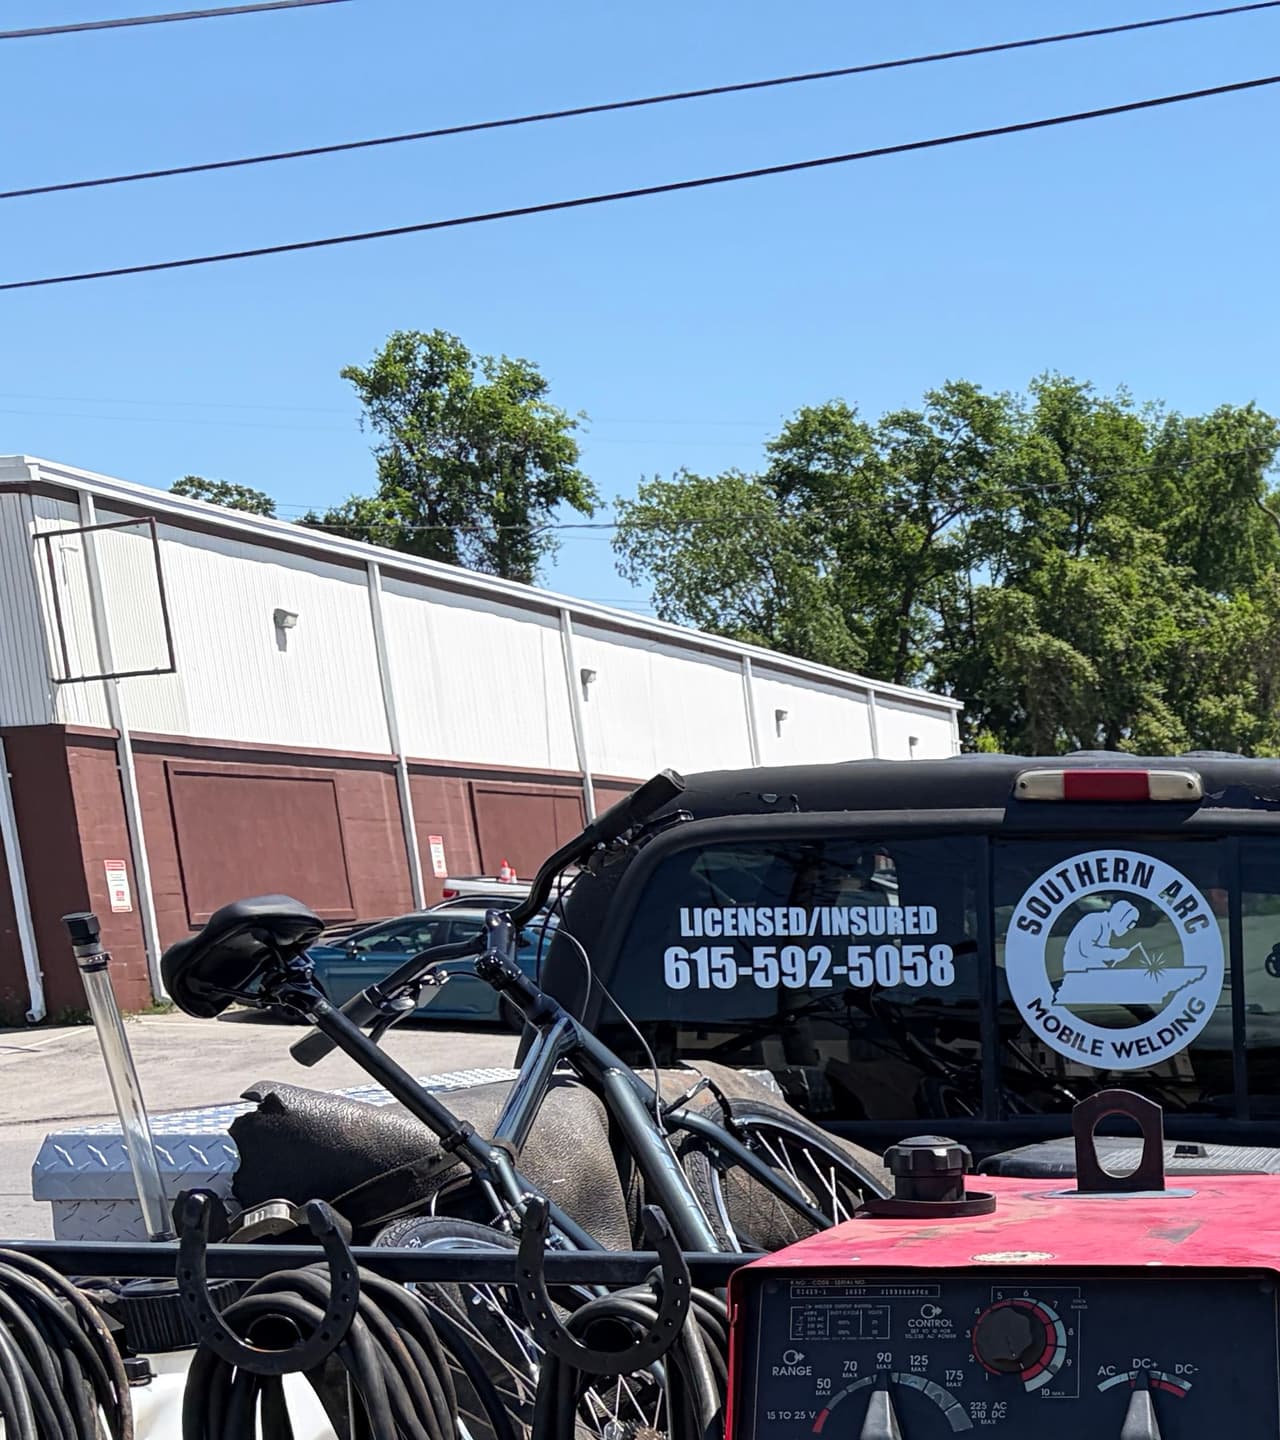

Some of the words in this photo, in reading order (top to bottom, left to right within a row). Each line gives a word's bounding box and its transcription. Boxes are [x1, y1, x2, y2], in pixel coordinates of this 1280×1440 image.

[1016, 857, 1155, 936] SOUTHERN
[1157, 879, 1209, 935] ARC
[680, 906, 937, 937] LICENSED/INSURED
[664, 944, 955, 989] 615-592-5058
[1027, 997, 1104, 1057] MOBILE
[1111, 997, 1206, 1058] WELDING
[907, 1319, 953, 1328] CONTROL
[1068, 1328, 1073, 1336] 8
[876, 1352, 892, 1363] 90
[910, 1355, 929, 1366] 125
[969, 1355, 974, 1363] 2
[843, 1361, 858, 1371] 70
[1066, 1359, 1072, 1367] 9
[1132, 1359, 1158, 1369] DC+
[772, 1366, 812, 1376] RANGE
[1097, 1366, 1116, 1376] AC
[1175, 1364, 1199, 1375] DC-
[945, 1370, 964, 1381] 175
[816, 1378, 831, 1389] 50
[1041, 1388, 1050, 1397] 10
[970, 1402, 987, 1410] 225
[992, 1402, 1007, 1410] AC
[767, 1411, 776, 1420] 15
[778, 1411, 792, 1420] TO
[794, 1411, 807, 1420] 25
[971, 1410, 986, 1418] 210
[991, 1410, 1006, 1418] DC
